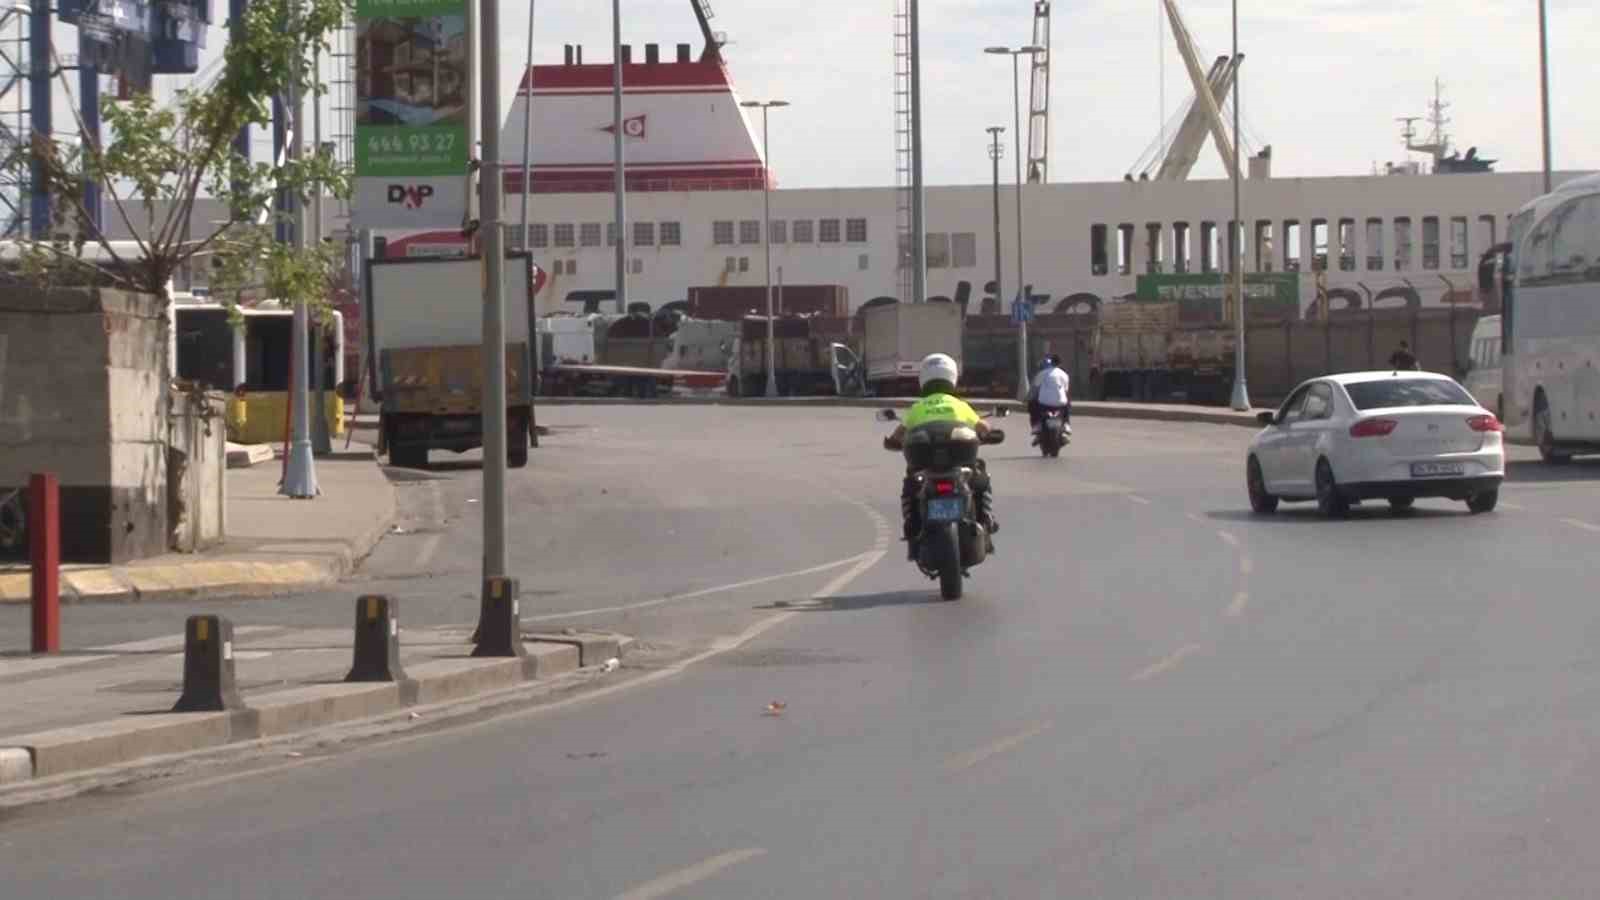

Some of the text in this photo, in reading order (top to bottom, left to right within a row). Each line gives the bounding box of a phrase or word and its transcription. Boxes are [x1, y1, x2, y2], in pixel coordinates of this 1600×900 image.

[368, 132, 455, 152] 444 93 27
